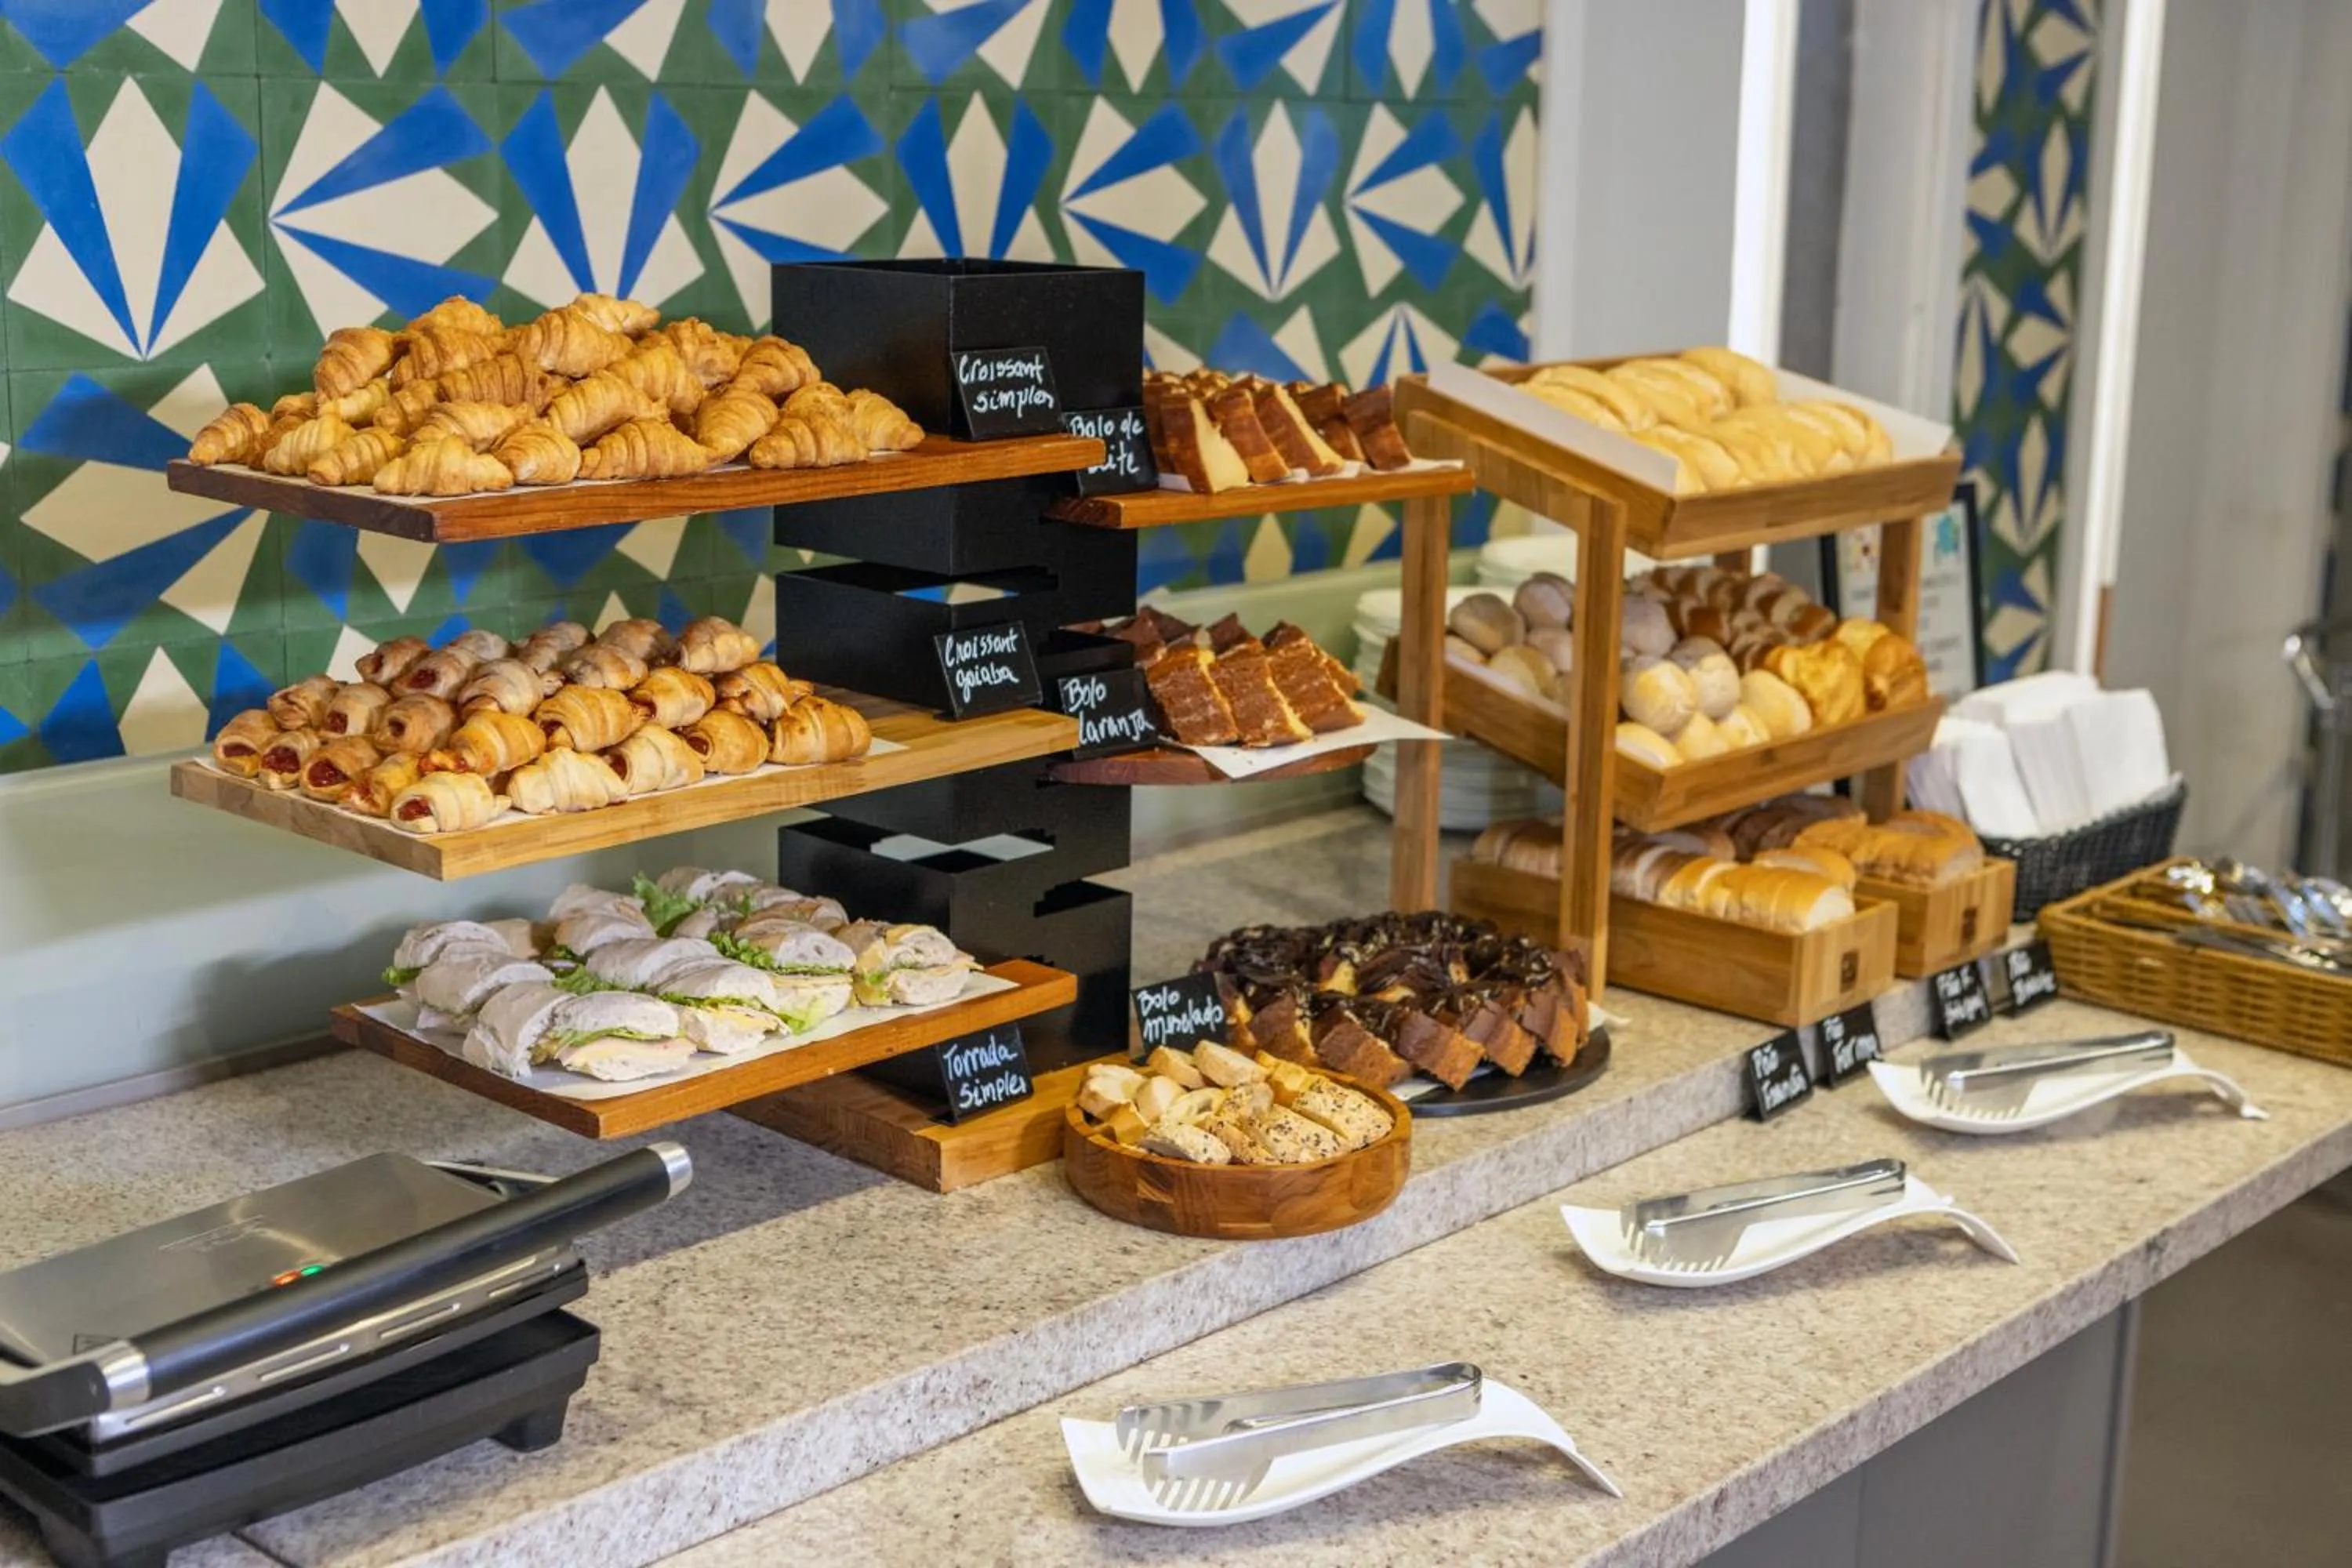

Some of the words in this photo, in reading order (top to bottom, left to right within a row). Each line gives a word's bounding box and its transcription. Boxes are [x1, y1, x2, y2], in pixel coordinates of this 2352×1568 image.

[959, 354, 1044, 385] Croissant
[1069, 415, 1115, 437] Bolo
[1120, 411, 1144, 440] de
[945, 628, 1018, 668] Croissant
[956, 662, 1020, 703] goiaba
[1064, 677, 1107, 713] Bolo
[1137, 985, 1181, 1017] Bolo
[942, 1033, 1018, 1081] Torrada
